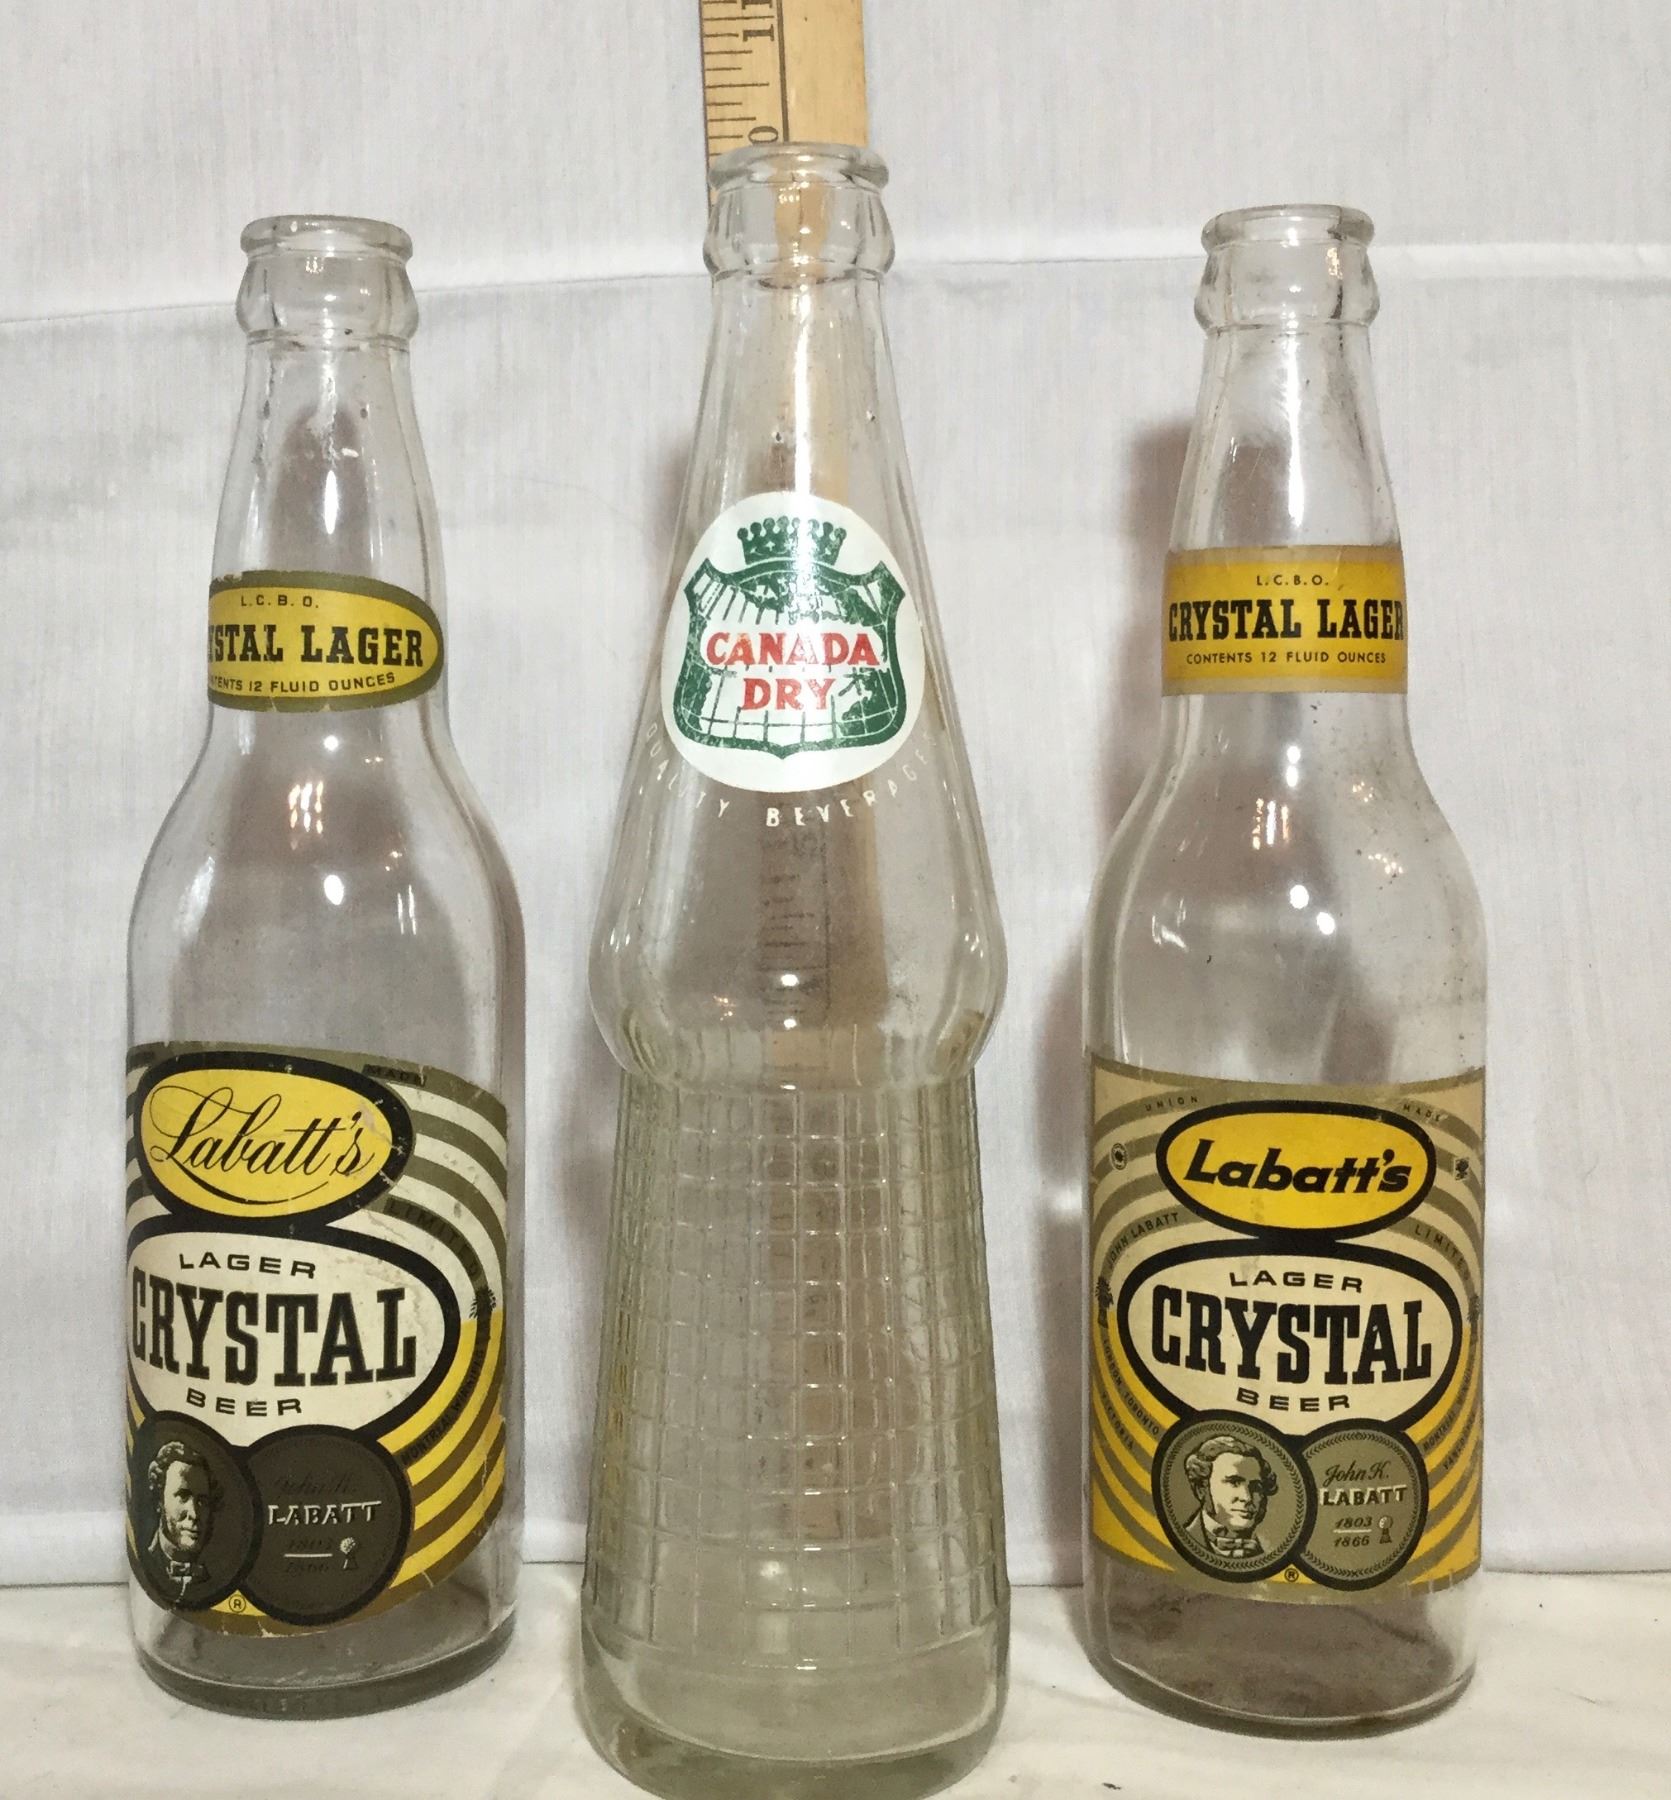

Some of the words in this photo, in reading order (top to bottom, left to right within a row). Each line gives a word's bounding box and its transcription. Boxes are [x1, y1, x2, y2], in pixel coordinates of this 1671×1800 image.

[1168, 598, 1302, 642] CRYSTAL
[1316, 598, 1404, 641] LAGER
[300, 624, 424, 667] LAGER
[706, 631, 881, 667] CANADA
[1186, 651, 1253, 665] CONTENTS
[1260, 651, 1277, 663] 12
[1286, 651, 1329, 663] FLUID
[1337, 651, 1386, 664] OUNCES
[249, 680, 263, 692] 12
[270, 680, 320, 693] FLUID
[328, 671, 396, 692] OUNCES
[739, 677, 836, 711] DRY
[1144, 1094, 1199, 1112] UNION
[1402, 1102, 1442, 1123] MADE
[149, 1085, 375, 1205] Labatt's
[1183, 1137, 1413, 1195] Labatt's
[1129, 1211, 1180, 1239] LABATT
[179, 1251, 317, 1280] LAGER
[1229, 1269, 1364, 1293] LAGER
[132, 1265, 417, 1388] CRYSTAL
[1150, 1282, 1433, 1386] CRYSTAL
[186, 1386, 302, 1417] BEER
[1124, 1391, 1160, 1436] TORONTO
[1236, 1387, 1351, 1412] BEER
[1322, 1459, 1367, 1488] John
[1319, 1484, 1408, 1506] LABATT
[266, 1500, 383, 1526] LABATT
[1334, 1516, 1373, 1529] 1803
[1333, 1535, 1371, 1548] 1866
